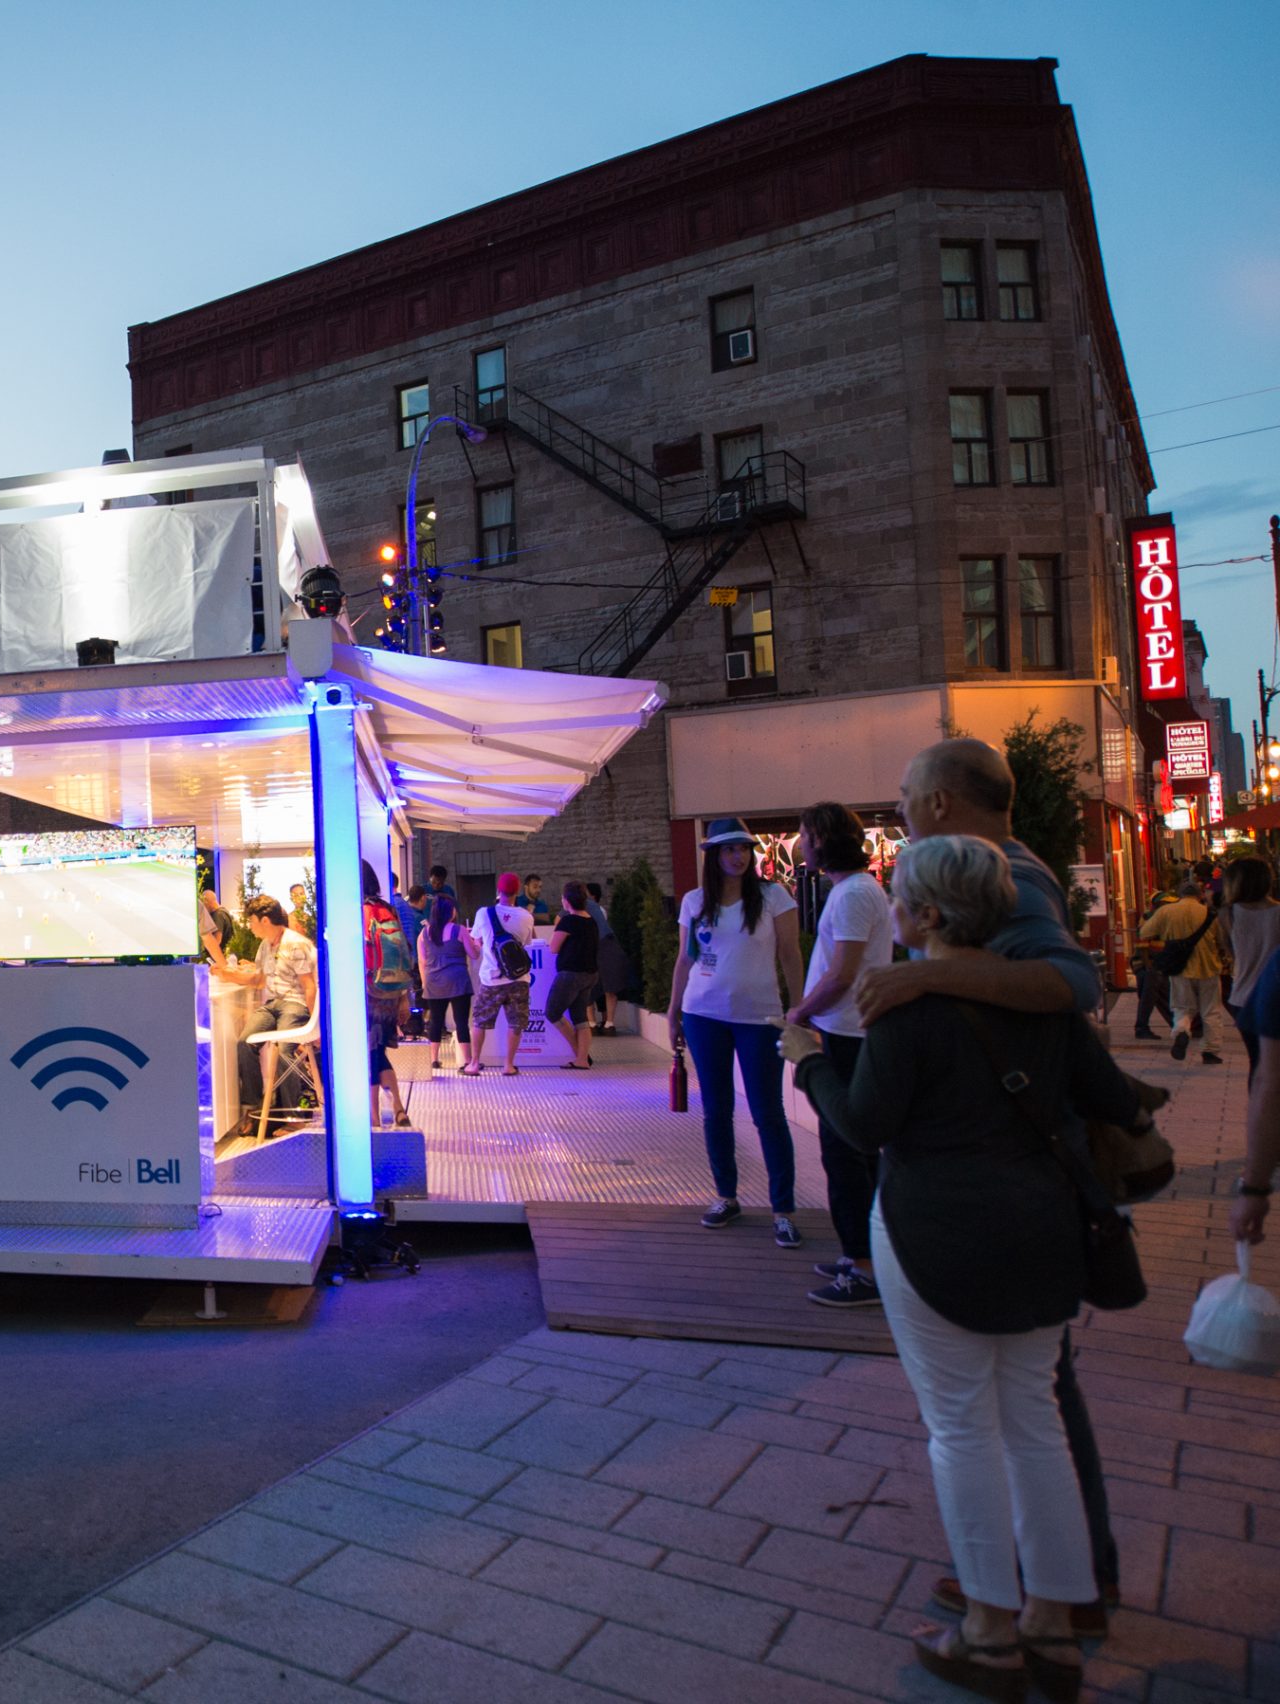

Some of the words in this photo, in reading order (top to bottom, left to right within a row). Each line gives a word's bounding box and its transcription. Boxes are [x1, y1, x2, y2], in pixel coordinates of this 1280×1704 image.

[1137, 537, 1177, 690] HÔTEL
[1171, 727, 1204, 735] HÔTEL
[1172, 754, 1205, 762] HÔTEL
[79, 1162, 122, 1184] Fibe
[136, 1158, 180, 1184] Bell
